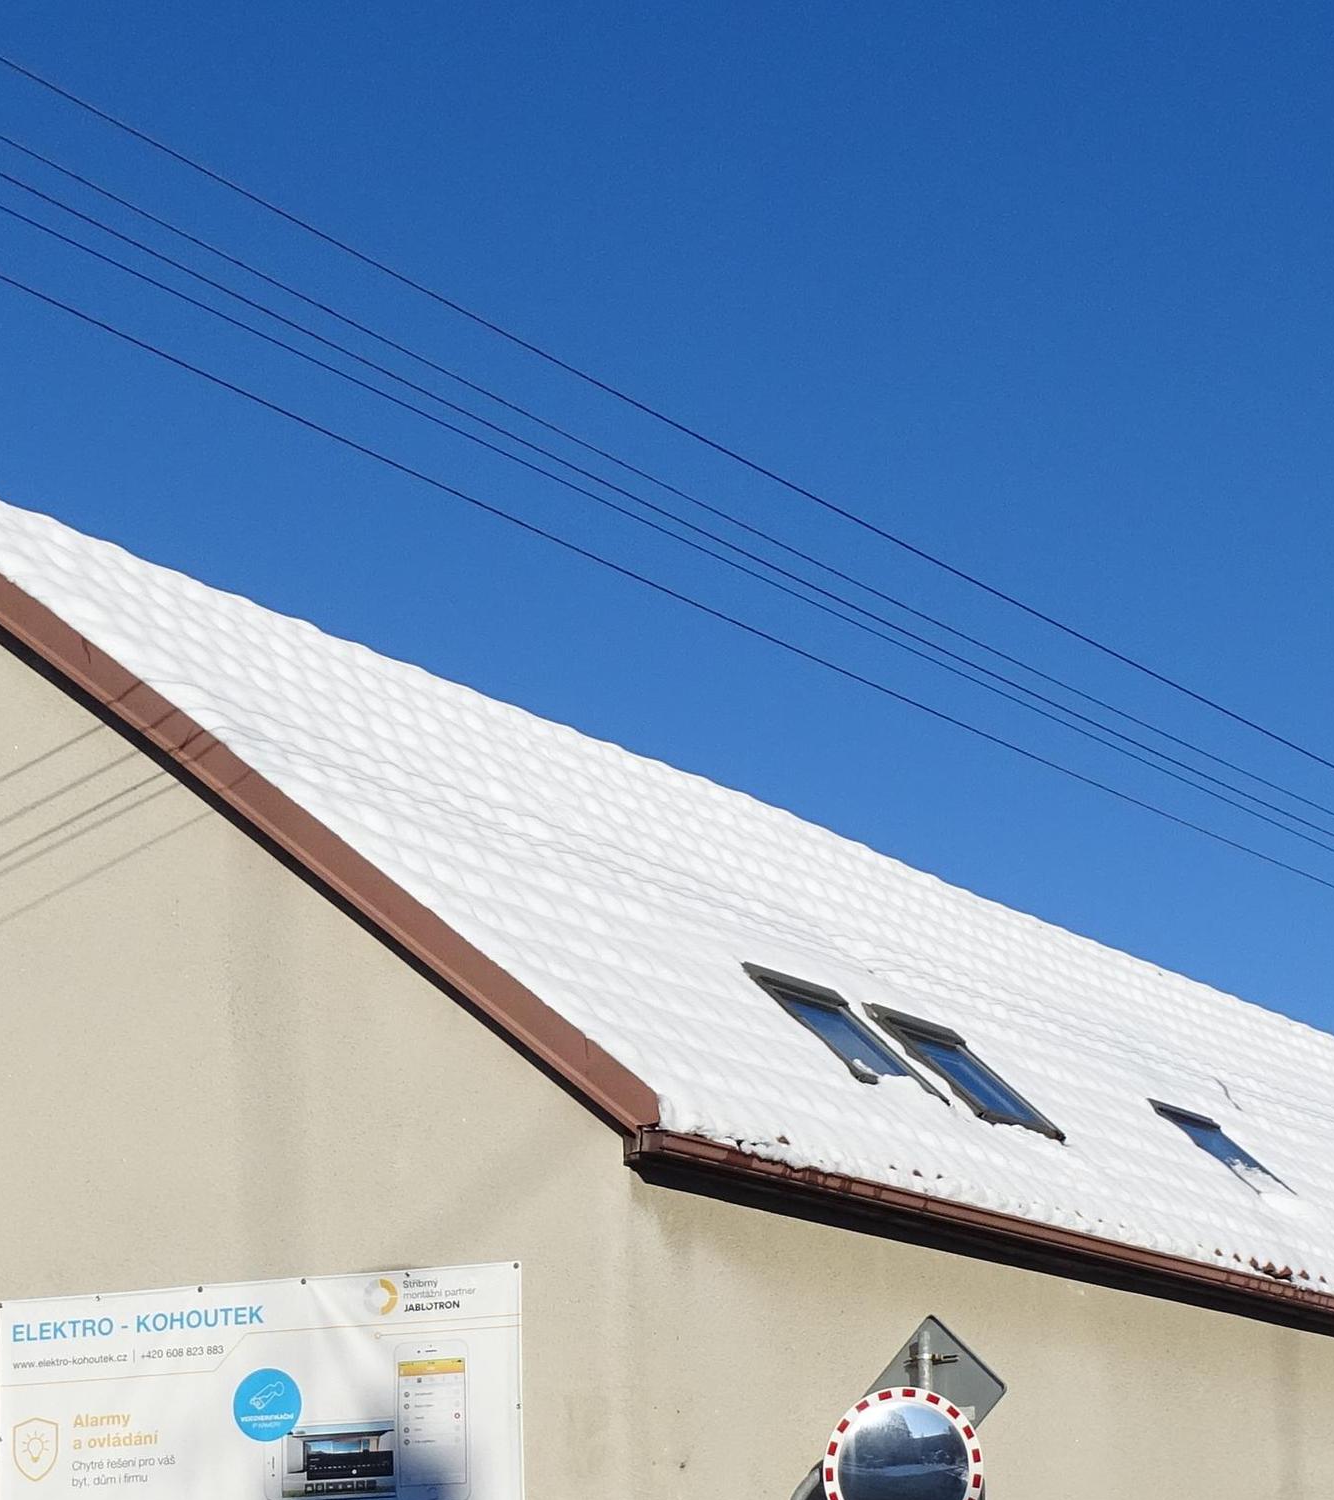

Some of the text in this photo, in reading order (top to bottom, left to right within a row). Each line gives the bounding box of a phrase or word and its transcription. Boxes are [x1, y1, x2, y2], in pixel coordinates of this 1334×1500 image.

[445, 1287, 476, 1298] partner
[404, 1300, 460, 1312] JABLOTRON
[12, 1317, 114, 1342] ELEKTRO
[136, 1306, 265, 1333] KOHOUTEK
[12, 1353, 128, 1370] www.elektro-kohoutek.cz
[140, 1349, 164, 1361] +420
[166, 1347, 184, 1358] 608
[186, 1345, 204, 1357] 823
[73, 1413, 131, 1429] Alarmy
[72, 1430, 159, 1450] a ovládání
[71, 1460, 105, 1473] Chytré
[138, 1457, 156, 1469] pro
[158, 1454, 176, 1466] váš
[93, 1473, 116, 1486] dům
[123, 1472, 149, 1483] firmu
